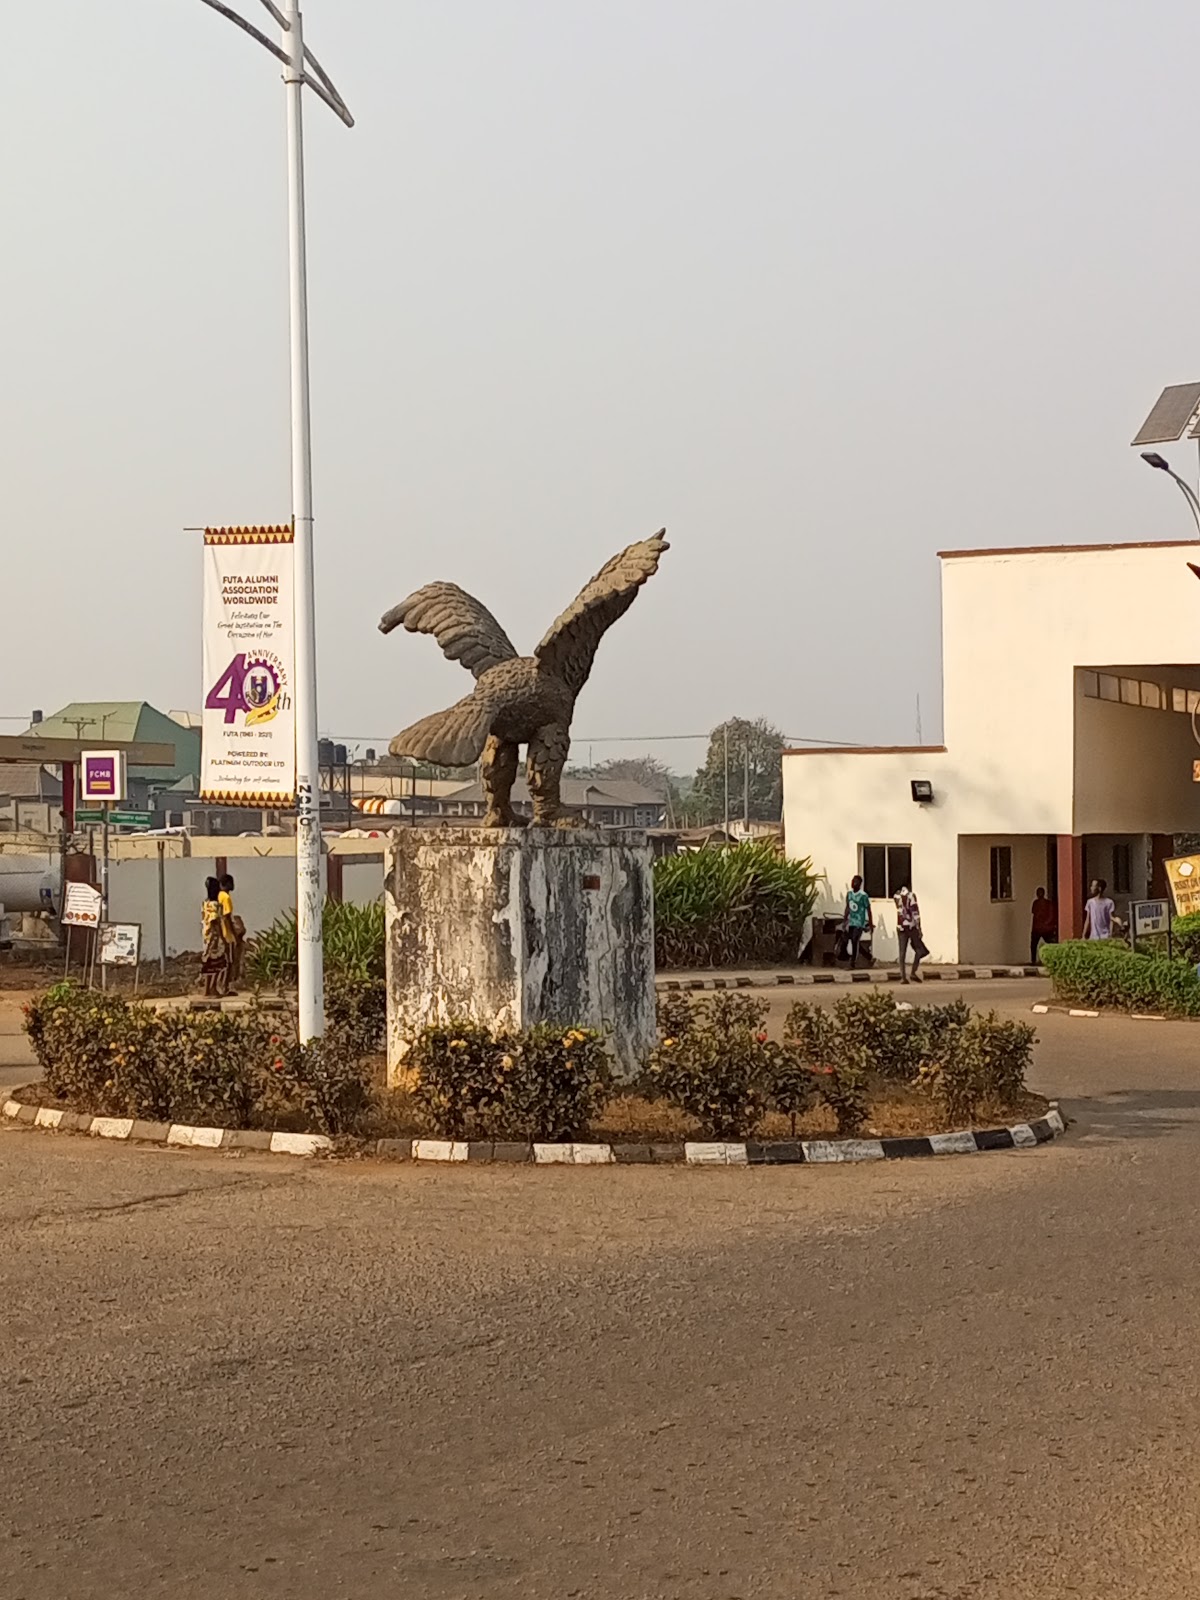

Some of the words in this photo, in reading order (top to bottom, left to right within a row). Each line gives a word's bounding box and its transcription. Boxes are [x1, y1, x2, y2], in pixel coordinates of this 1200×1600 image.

[223, 576, 243, 584] FUTA
[245, 575, 279, 584] ALUMNI
[221, 586, 279, 594] ASSOCIATION
[222, 596, 278, 604] WORLDWIDE
[247, 649, 288, 686] ANNIVERSARY
[223, 730, 239, 738] FUTA
[273, 760, 285, 768] LTD
[90, 770, 110, 778] FCMB
